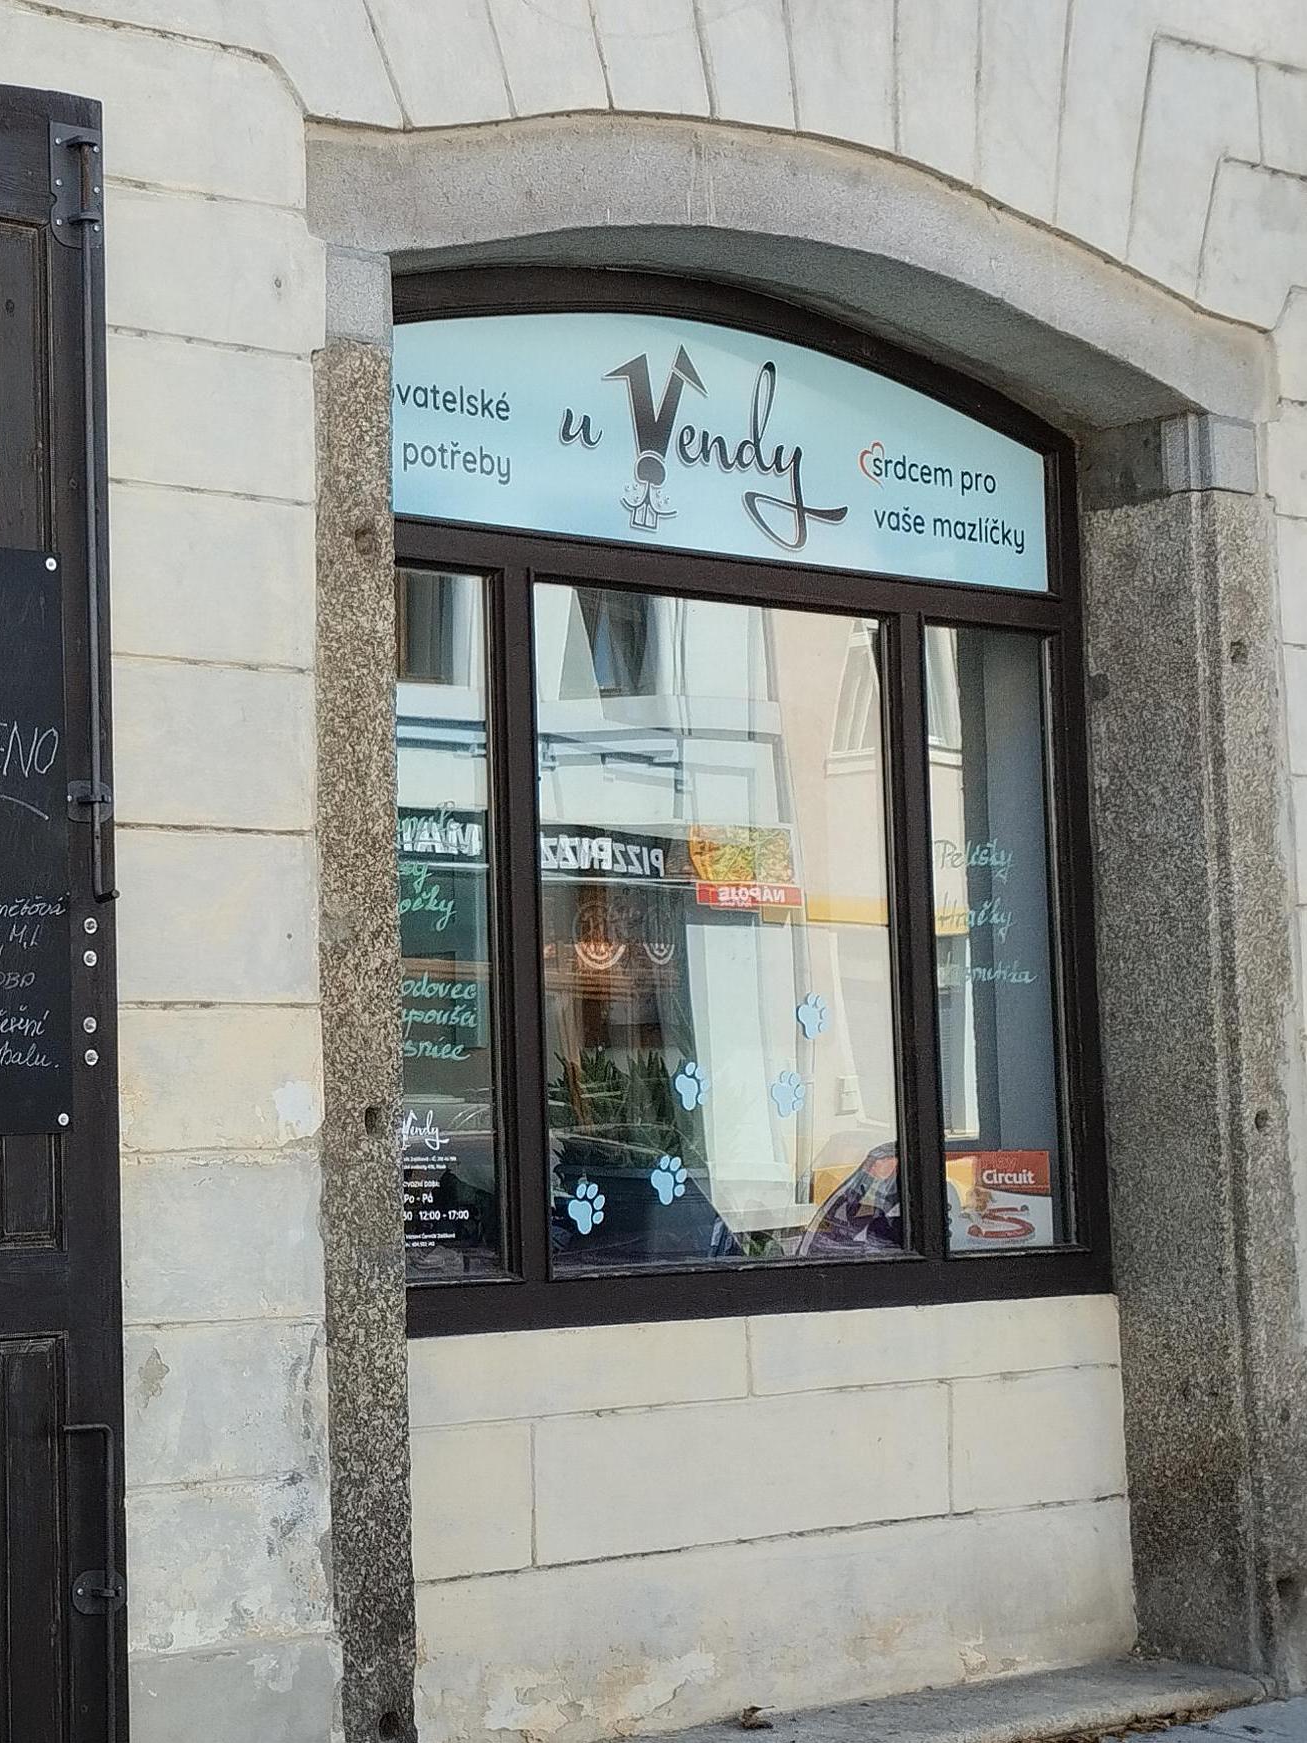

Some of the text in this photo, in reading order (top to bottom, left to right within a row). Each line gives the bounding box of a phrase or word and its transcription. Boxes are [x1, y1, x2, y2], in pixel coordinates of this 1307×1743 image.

[393, 382, 511, 421] vatelské
[402, 440, 511, 485] potřeby
[561, 344, 849, 550] u Vendy
[872, 454, 997, 496] srdcem pro
[874, 506, 1026, 555] vaše mazlíčky
[982, 1168, 1035, 1185] Circuit
[418, 1210, 441, 1221] 12:00
[448, 1210, 470, 1220] 17:00
